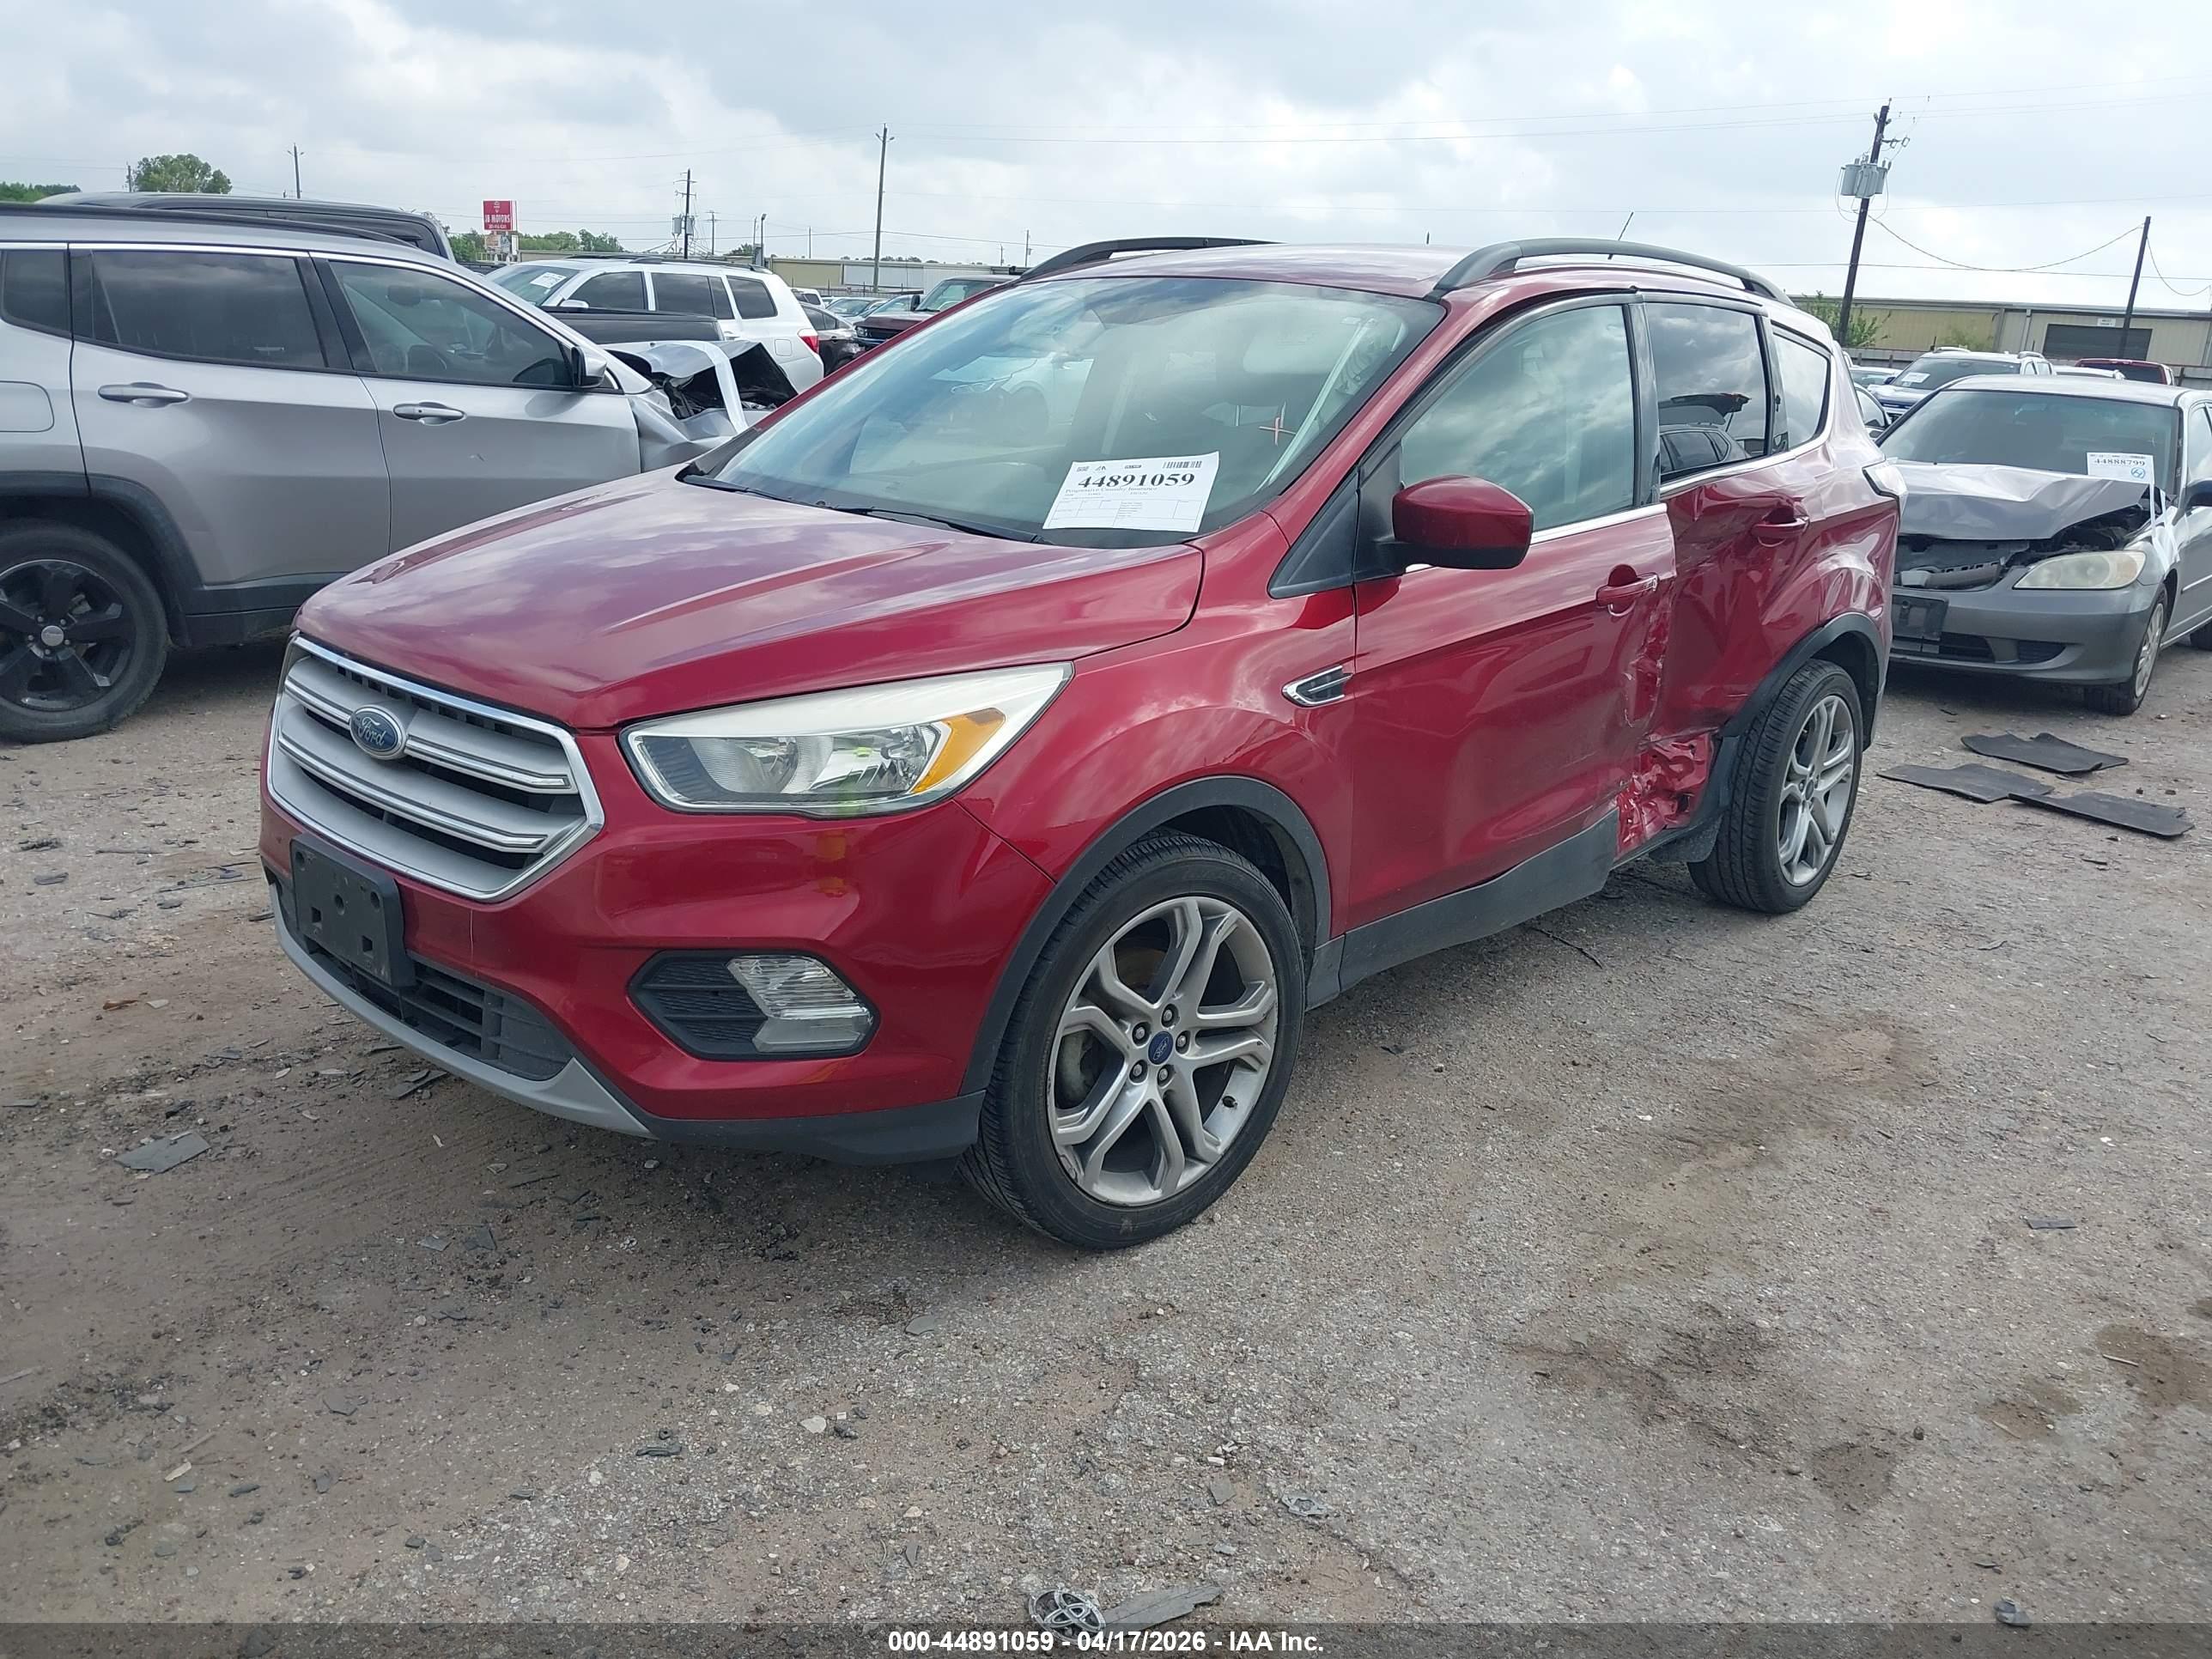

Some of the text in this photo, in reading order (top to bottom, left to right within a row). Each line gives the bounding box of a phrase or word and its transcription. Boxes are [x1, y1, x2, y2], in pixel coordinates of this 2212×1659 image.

[491, 214, 511, 223] MOTORS
[1078, 472, 1195, 489] 44891059
[357, 716, 386, 746] Ford
